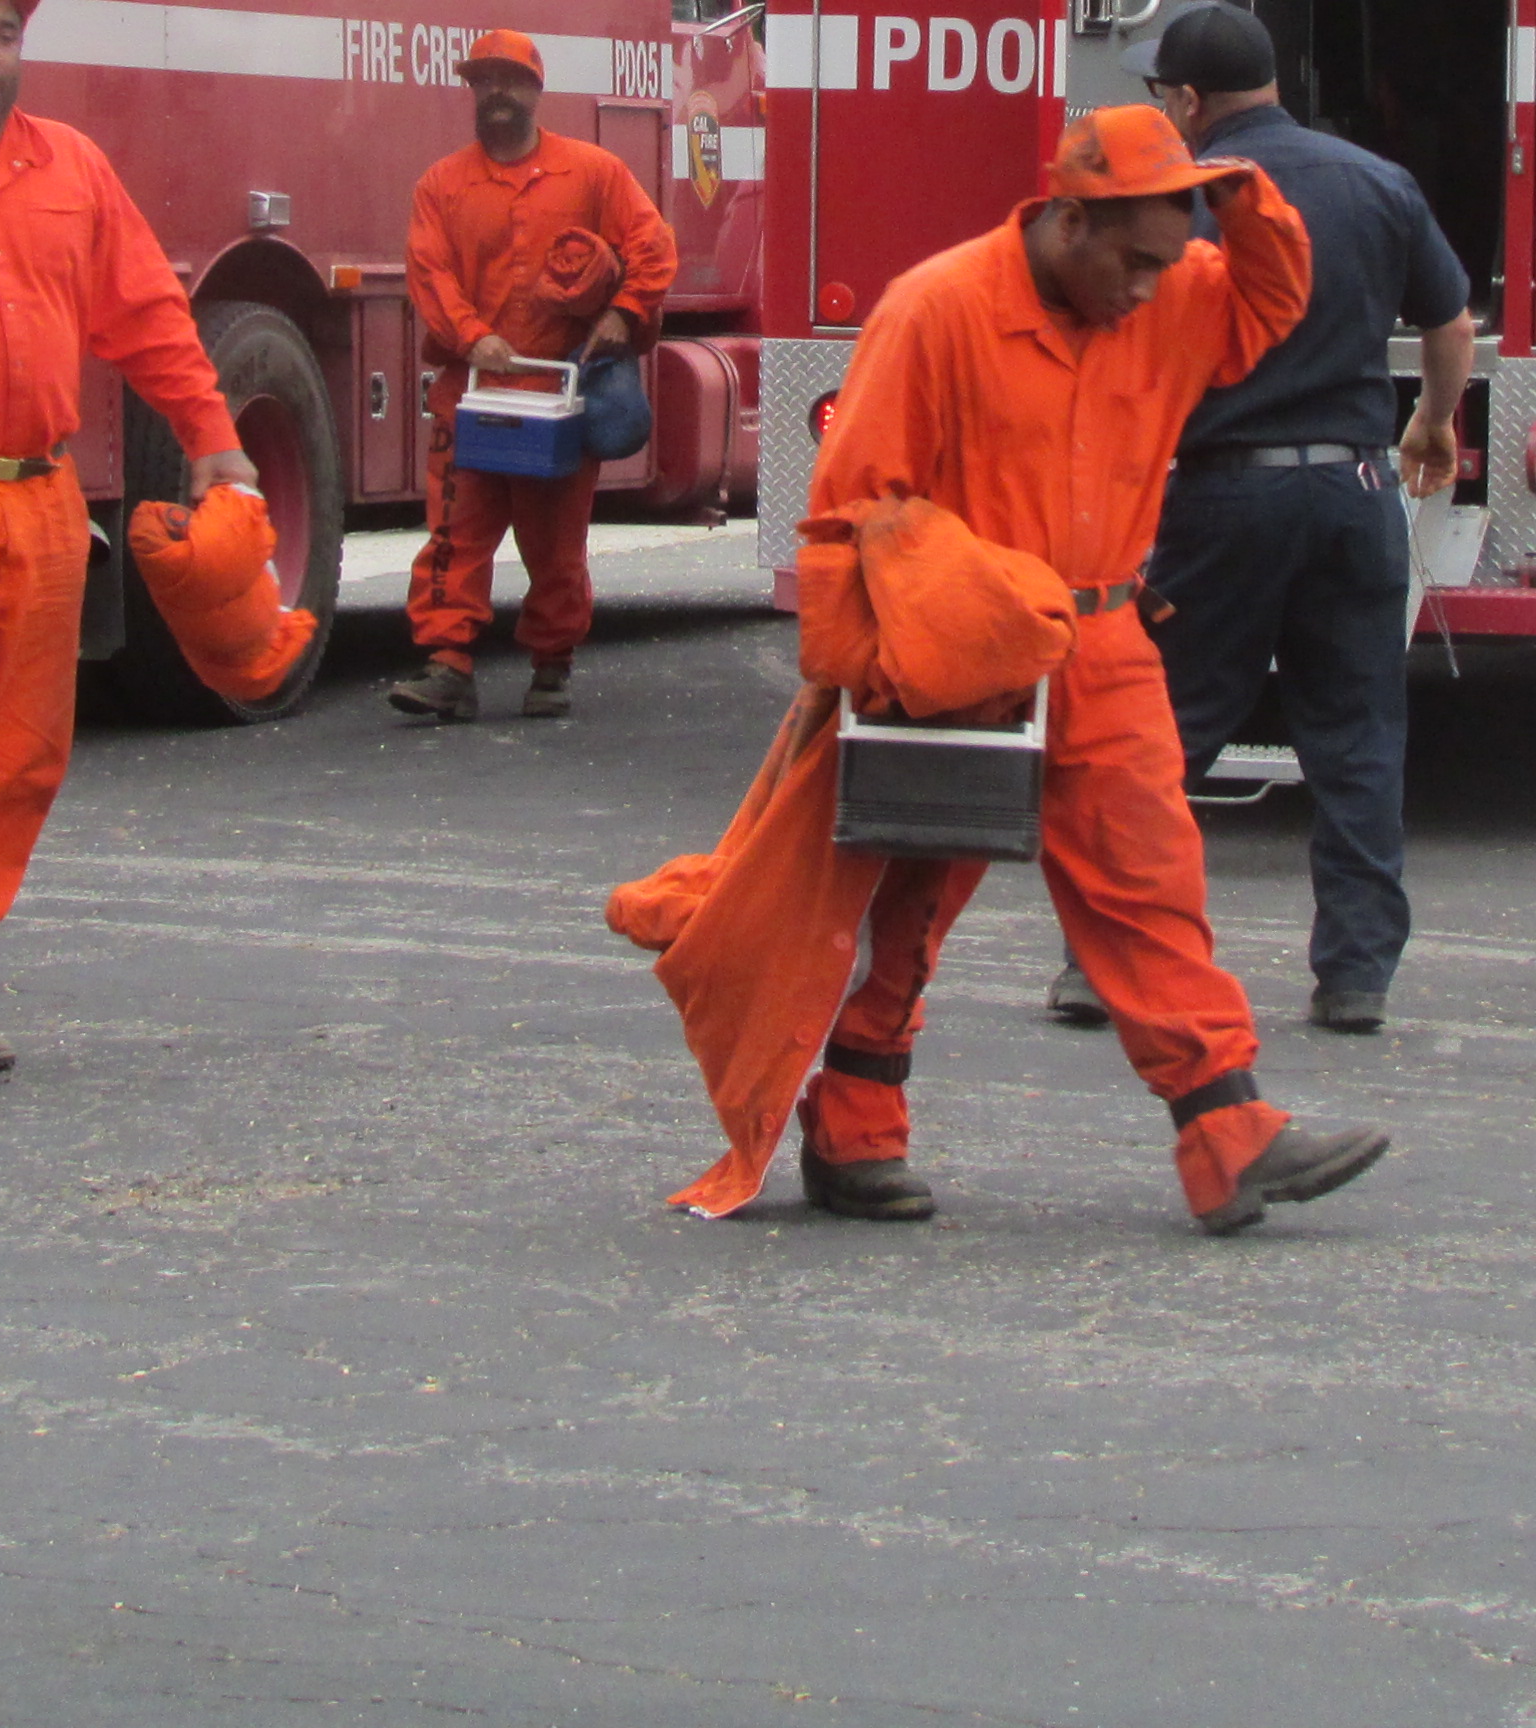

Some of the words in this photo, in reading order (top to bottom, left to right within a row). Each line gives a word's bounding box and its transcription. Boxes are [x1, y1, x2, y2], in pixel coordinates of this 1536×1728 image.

[346, 18, 404, 84] FIRE
[693, 116, 710, 133] CAL
[701, 133, 719, 150] FIRE
